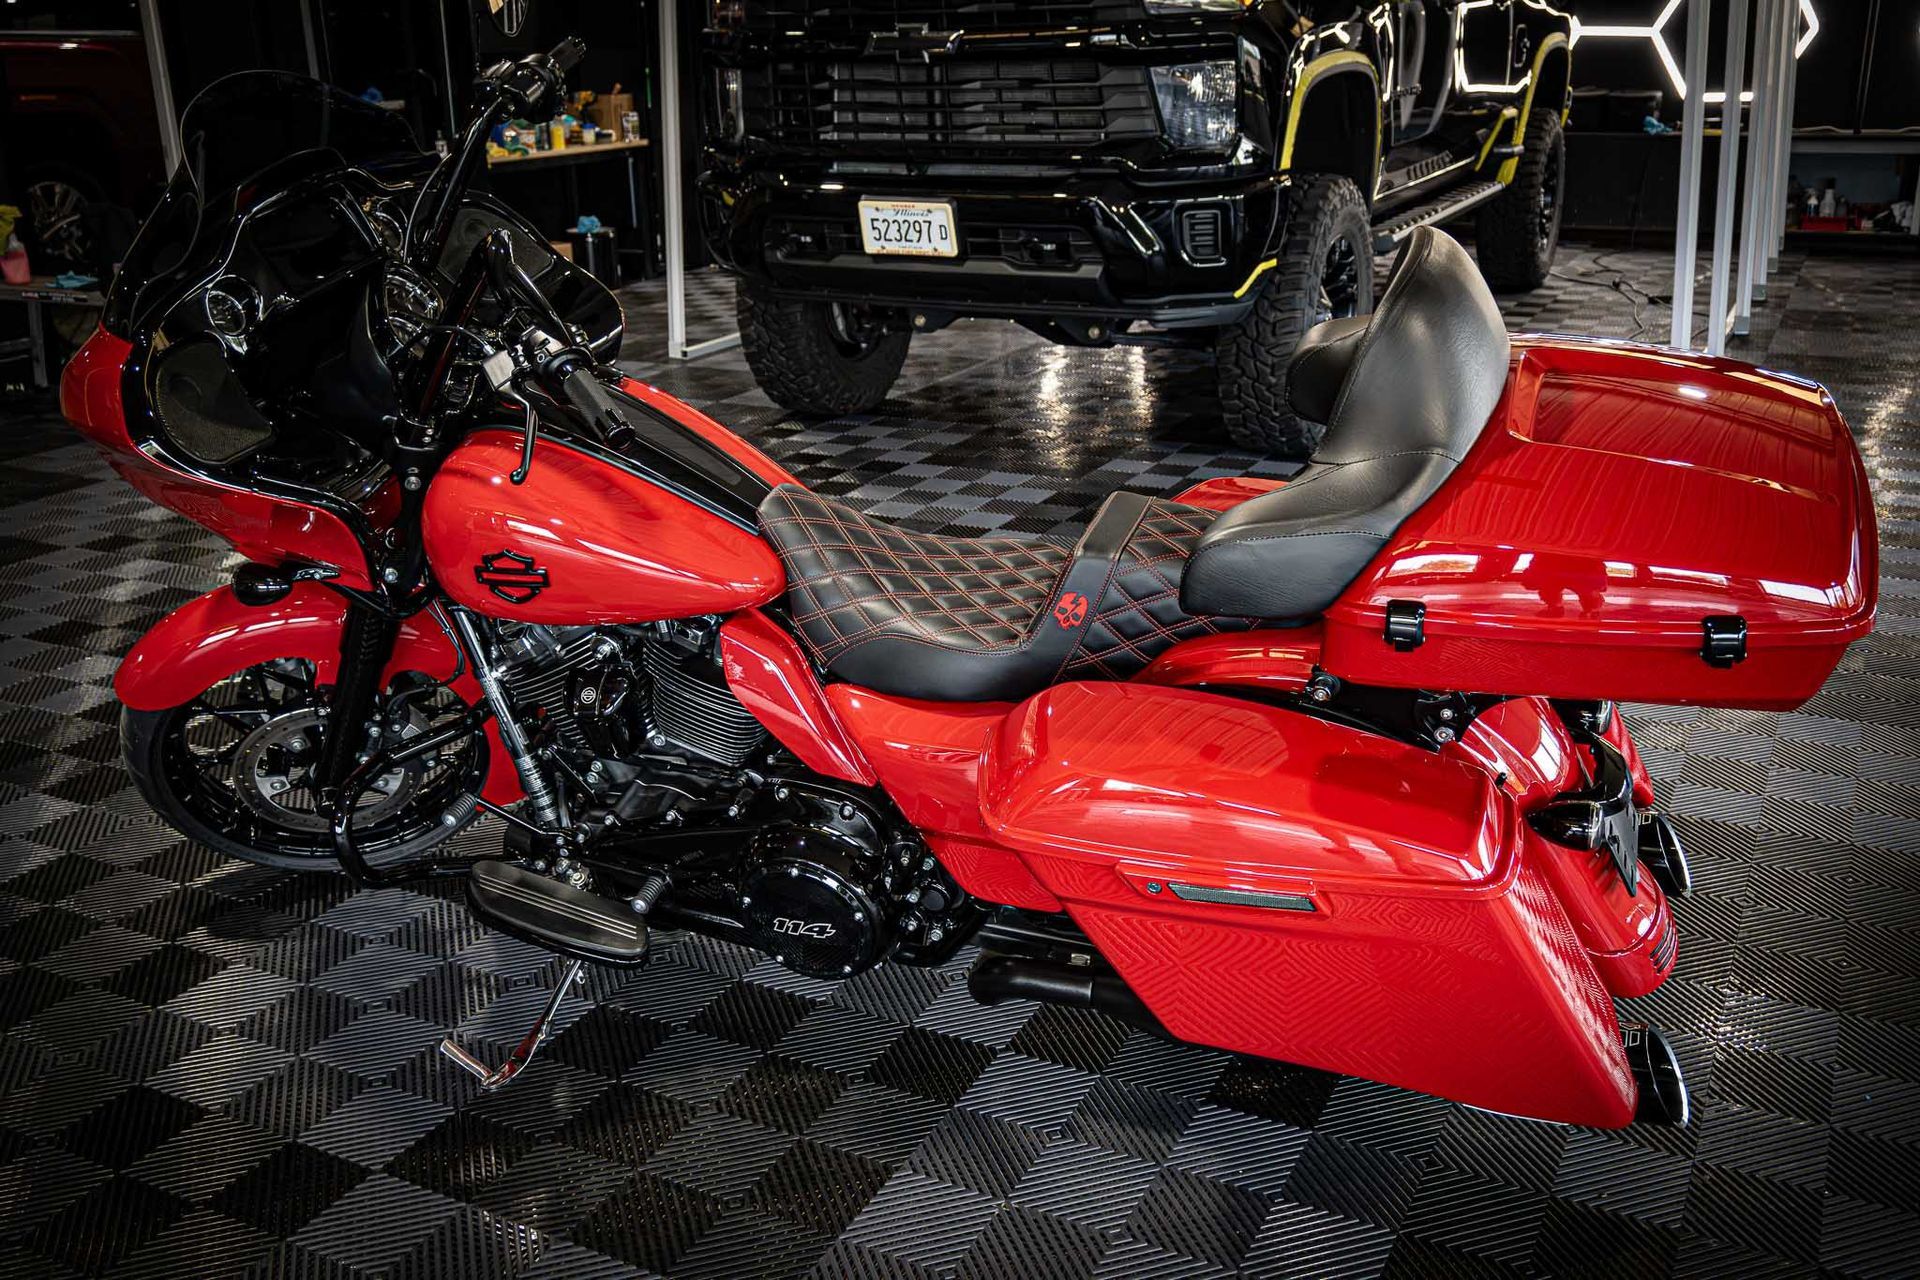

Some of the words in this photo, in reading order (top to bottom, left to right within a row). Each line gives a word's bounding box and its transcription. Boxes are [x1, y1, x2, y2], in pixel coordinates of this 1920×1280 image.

[870, 218, 932, 243] 523297
[939, 224, 948, 240] D
[773, 917, 836, 939] 114
